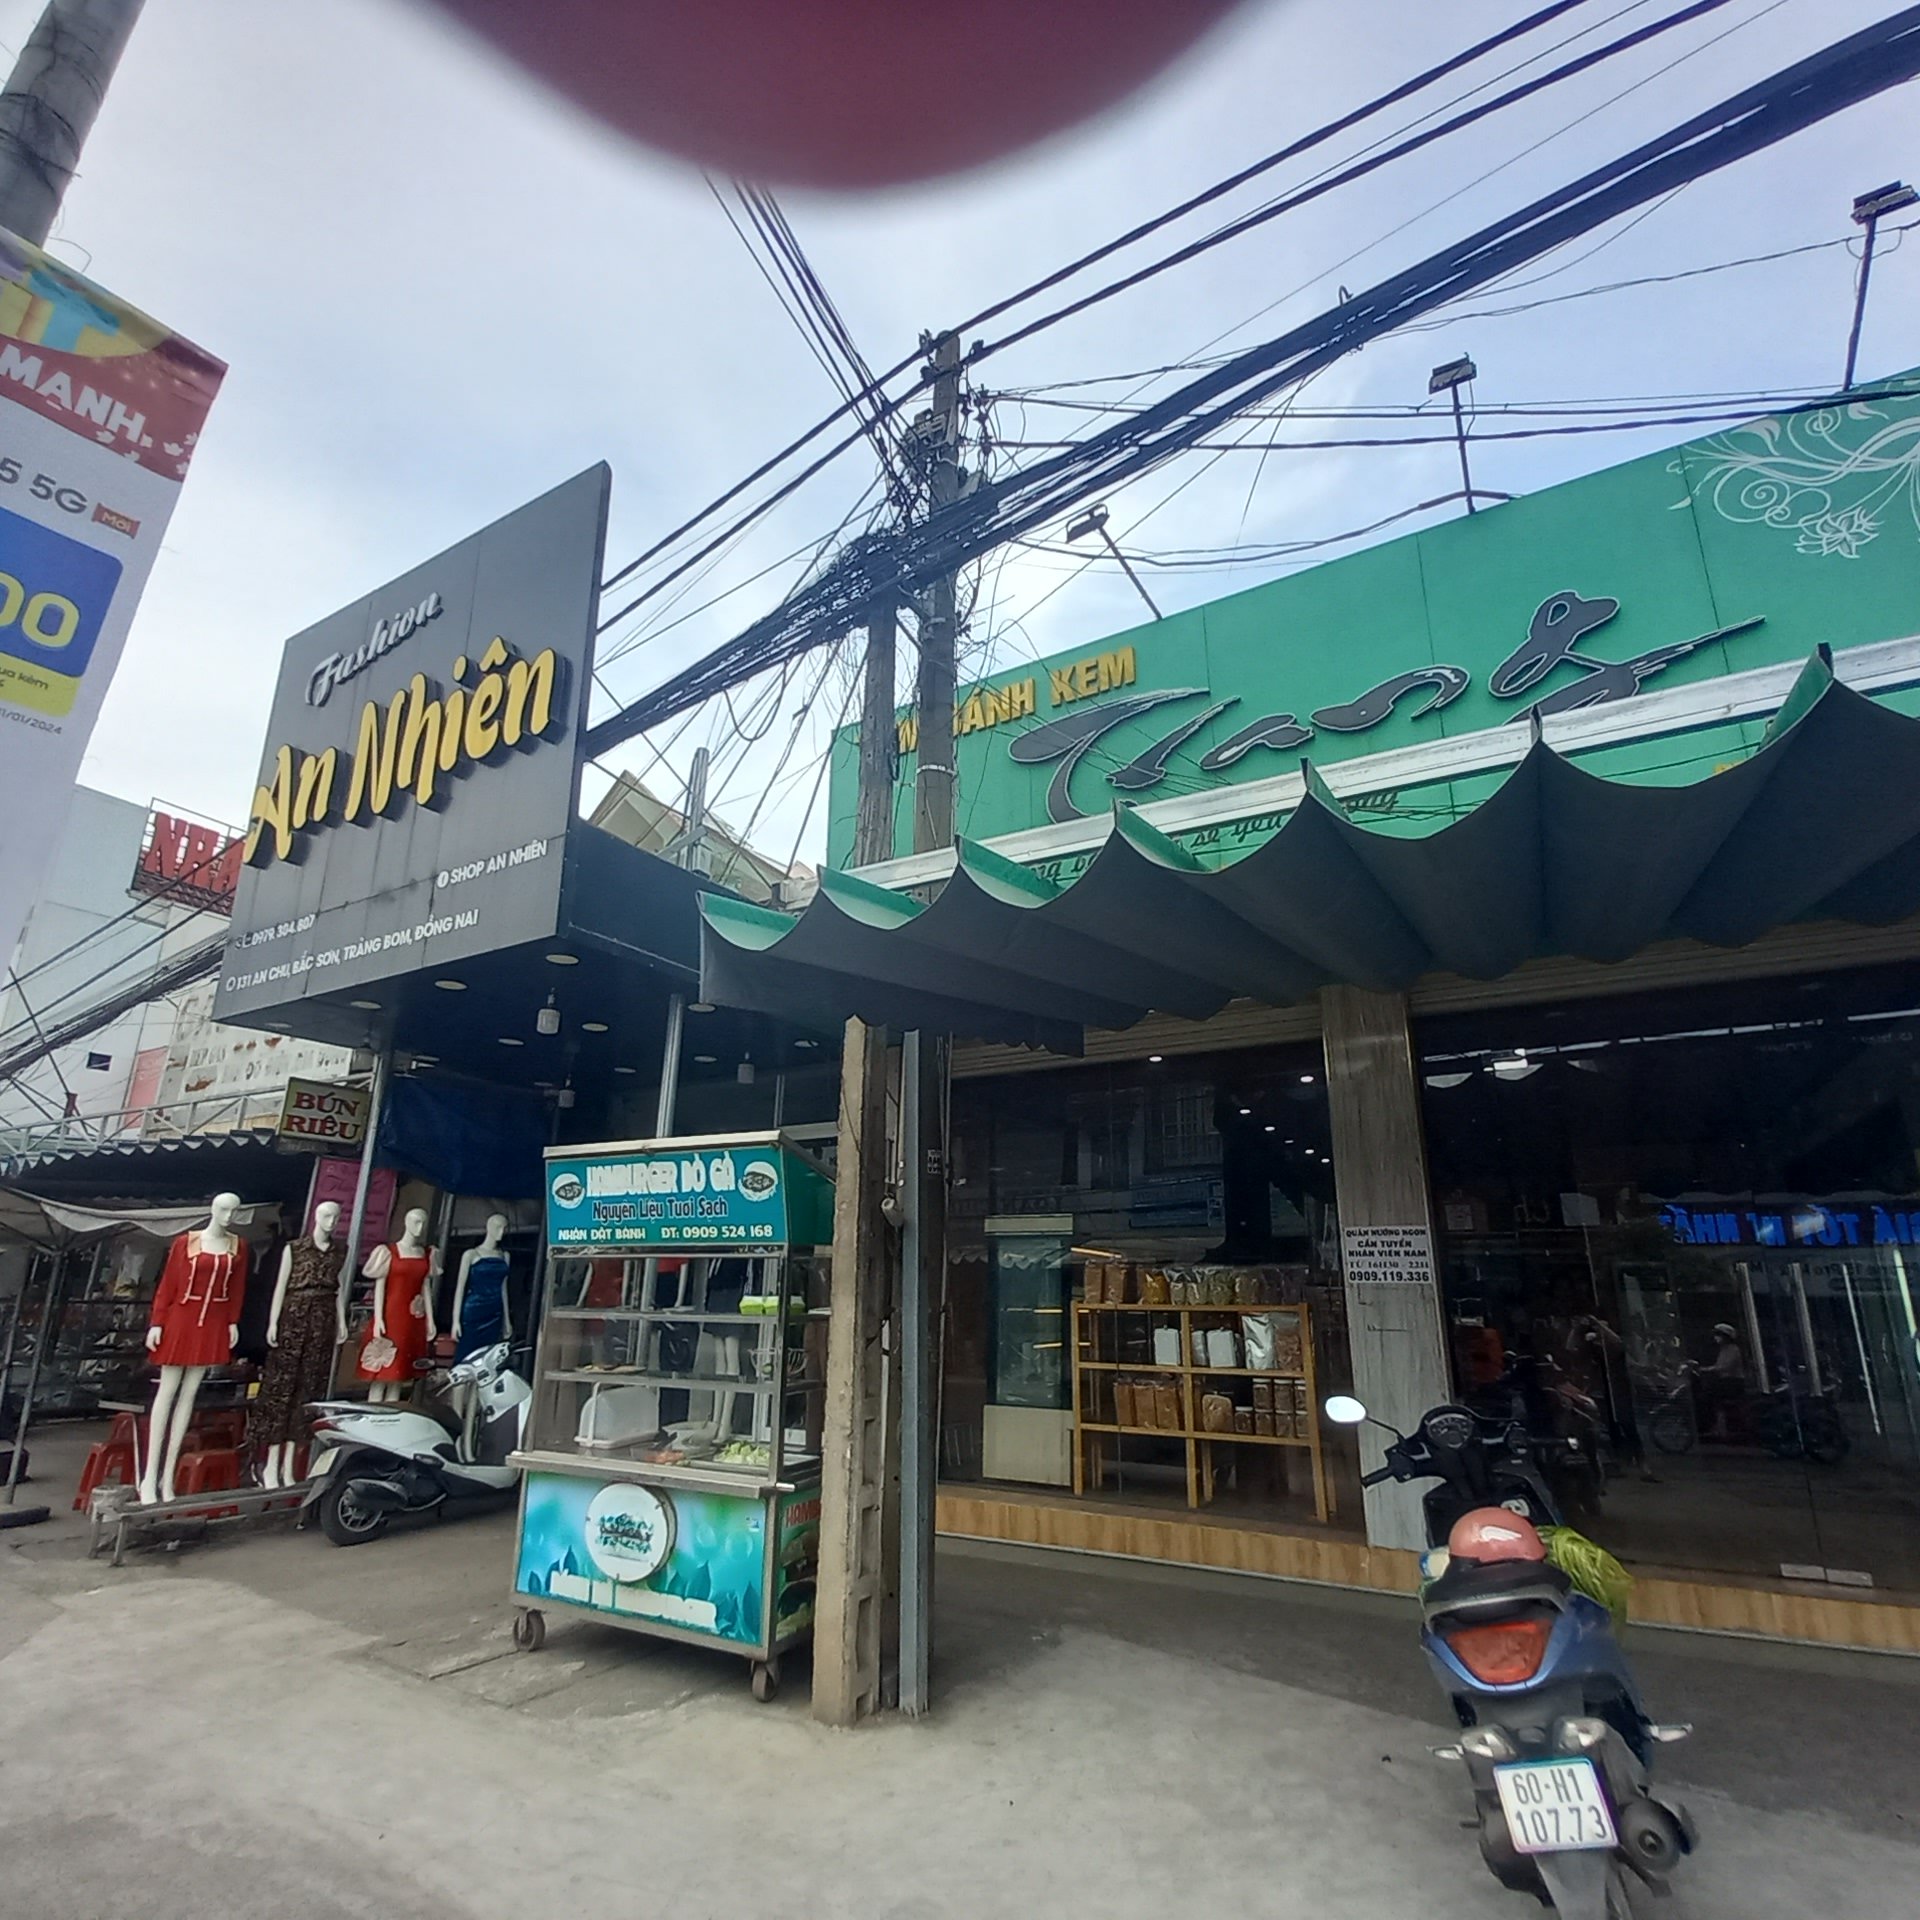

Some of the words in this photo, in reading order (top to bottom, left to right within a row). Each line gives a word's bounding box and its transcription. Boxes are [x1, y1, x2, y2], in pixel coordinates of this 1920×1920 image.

[29, 472, 88, 514] 5G
[305, 591, 440, 707] Fashion
[1050, 645, 1137, 707] KEM
[243, 743, 338, 864] An
[343, 635, 557, 806] Nhiên
[450, 860, 484, 884] SHOP
[486, 852, 507, 874] AN
[509, 839, 548, 867] NHIÊN
[453, 908, 479, 931] NAI
[292, 1091, 361, 1118] BÚN
[283, 1113, 362, 1140] RIÊU
[682, 1225, 719, 1239] 0909
[720, 1224, 746, 1238] 524
[749, 1223, 774, 1238] 168
[1404, 1249, 1427, 1257] NAM
[1349, 1271, 1430, 1281] 0909.119.336
[1515, 1804, 1608, 1846] 107.73
